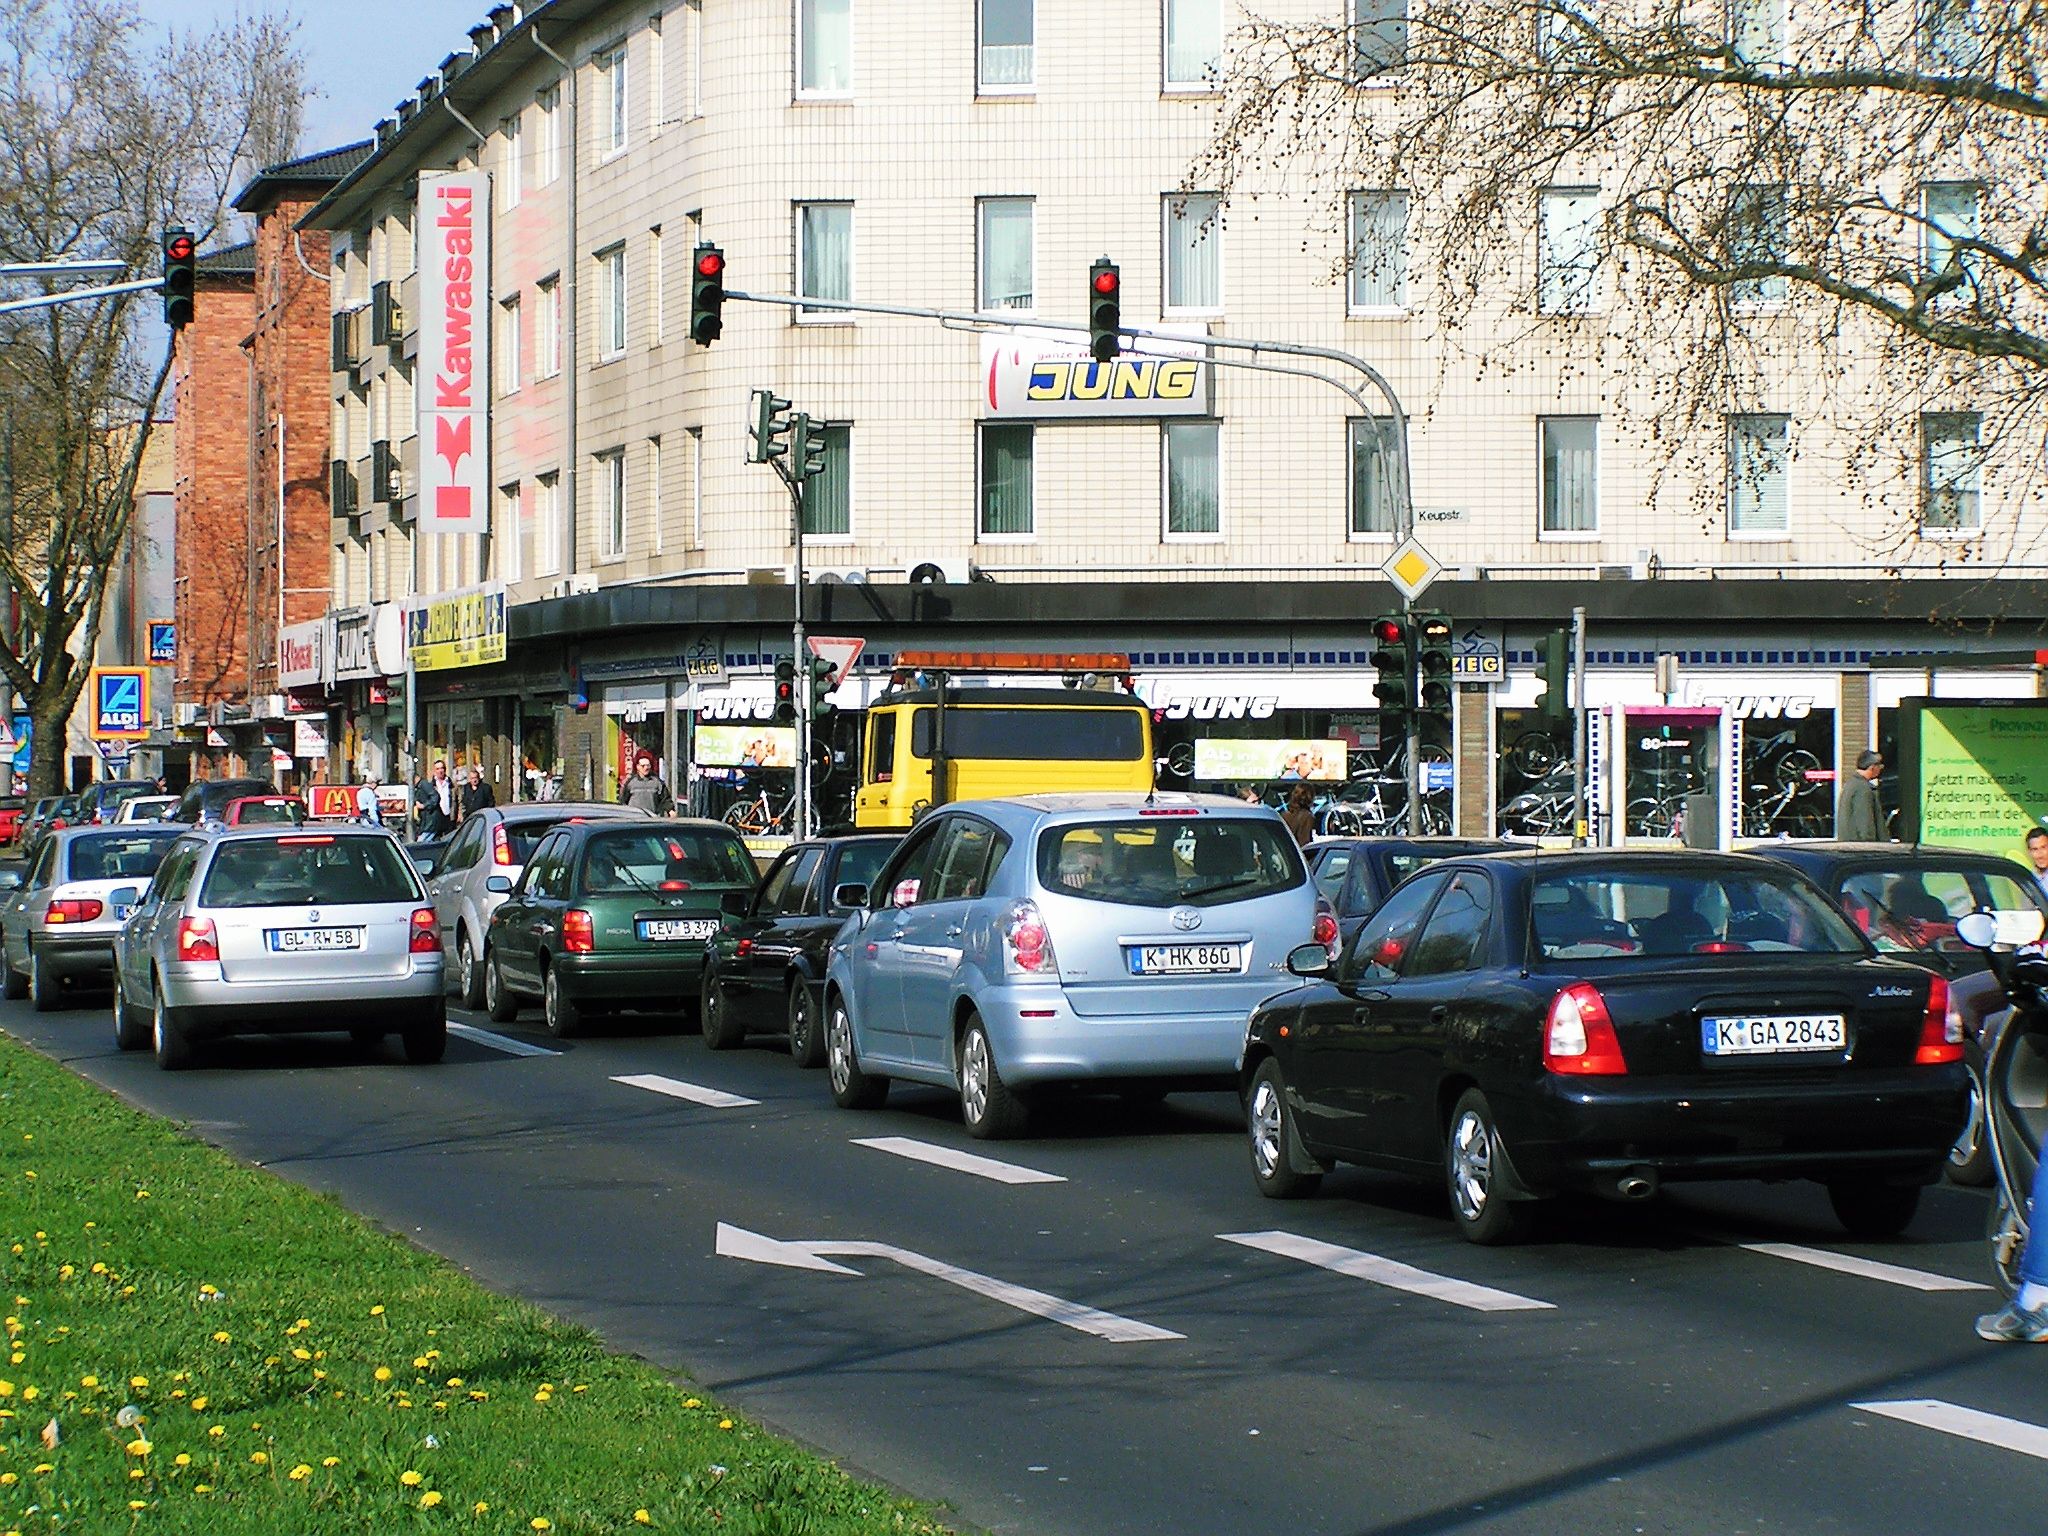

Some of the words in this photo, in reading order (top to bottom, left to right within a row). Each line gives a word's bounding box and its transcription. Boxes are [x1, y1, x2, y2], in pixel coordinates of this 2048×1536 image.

[436, 187, 472, 407] Kawasaki
[1027, 362, 1198, 400] JUNG
[1418, 510, 1463, 521] Keupstr.
[689, 659, 719, 675] ZEG
[1452, 657, 1499, 672] ZEG
[701, 697, 775, 720] JUNG
[1166, 696, 1279, 719] JUNG
[99, 712, 139, 725] ALDI
[1967, 772, 2028, 785] maximale
[1927, 790, 1991, 805] Förderung
[1979, 810, 2000, 819] mit
[2003, 809, 2024, 819] der
[648, 921, 673, 935] LEV
[683, 922, 690, 934] B
[285, 932, 304, 945] GL
[313, 931, 332, 944] RW
[336, 930, 353, 944] 58
[1147, 948, 1157, 967] K
[1170, 948, 1193, 966] HK
[1199, 947, 1230, 965] 860
[1720, 1022, 1734, 1045] K
[1750, 1021, 1780, 1044] GA
[1785, 1019, 1841, 1043] 2843
